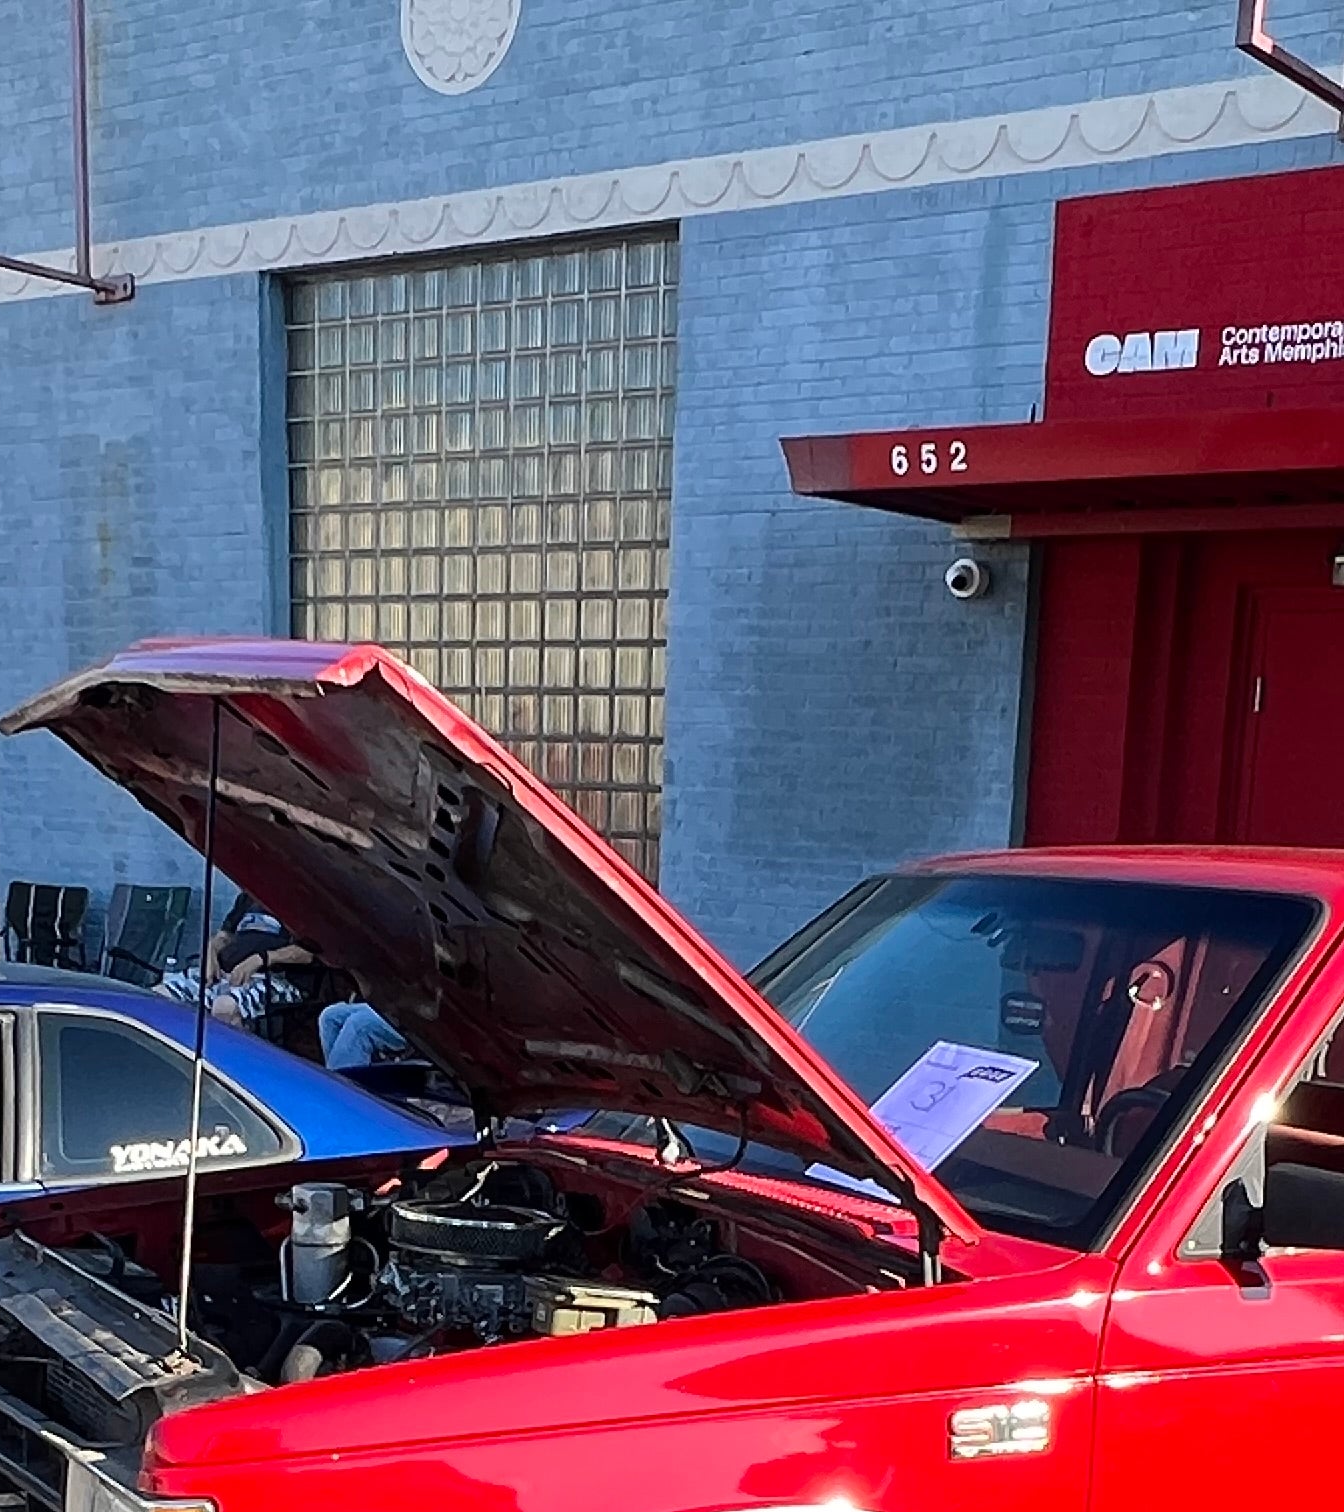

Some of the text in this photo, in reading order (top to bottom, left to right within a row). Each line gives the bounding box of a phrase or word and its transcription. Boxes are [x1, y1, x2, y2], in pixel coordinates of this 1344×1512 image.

[1084, 328, 1200, 376] CAM
[1218, 345, 1260, 367] Arts
[110, 1134, 248, 1168] YONAKA
